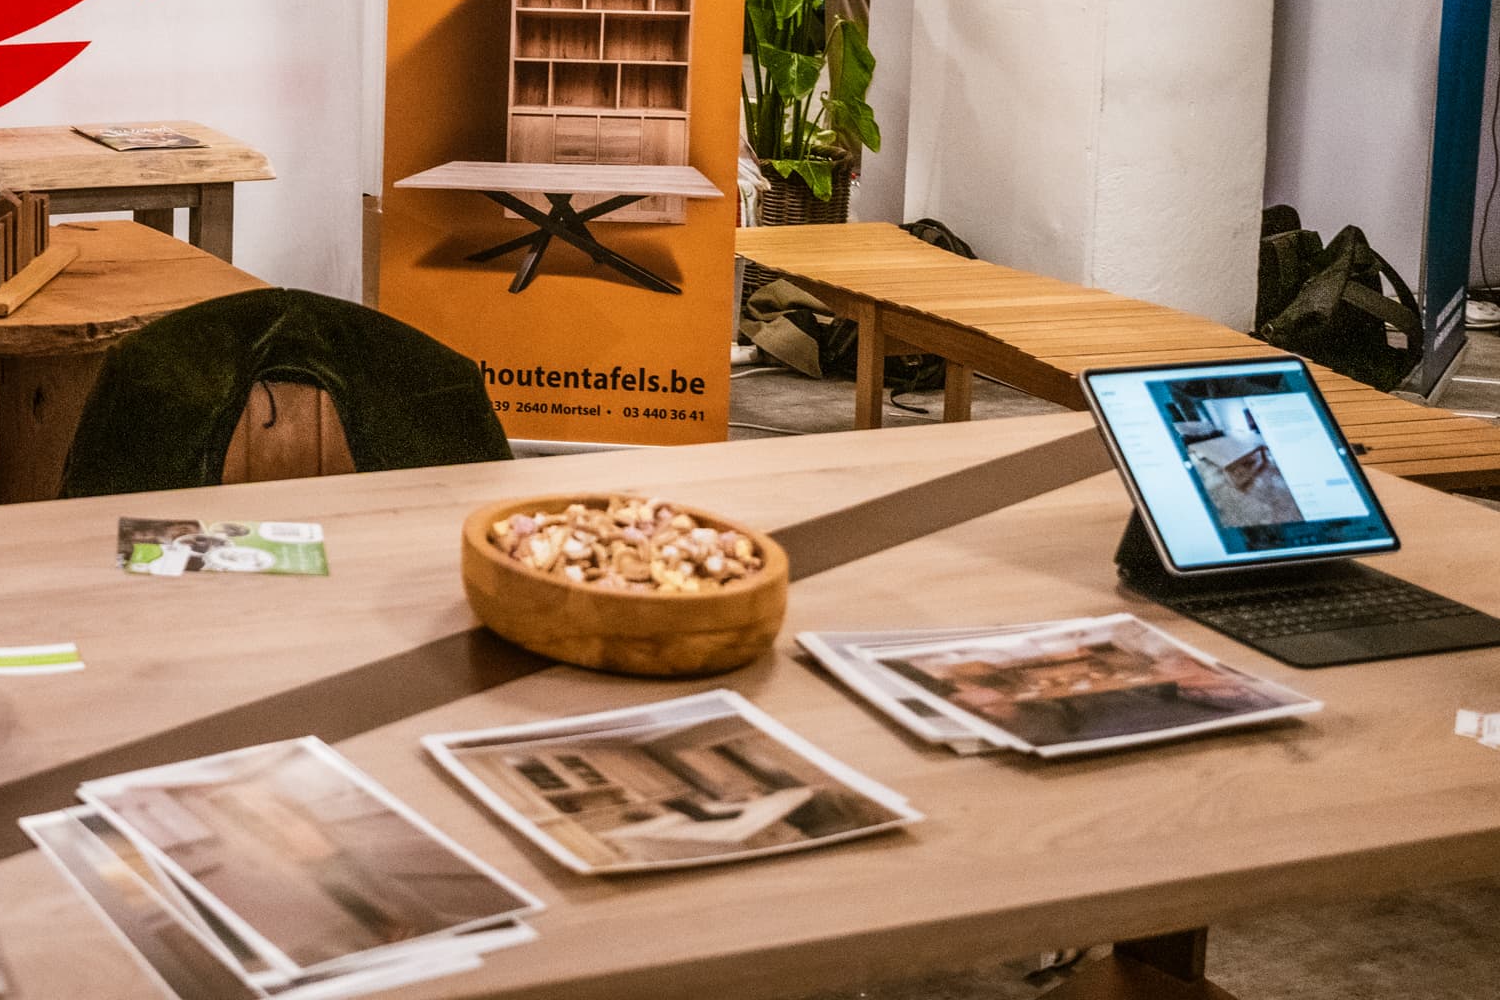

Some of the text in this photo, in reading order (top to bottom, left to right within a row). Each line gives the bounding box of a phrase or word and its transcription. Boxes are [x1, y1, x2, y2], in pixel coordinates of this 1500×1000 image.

[515, 402, 548, 414] 2640
[551, 403, 601, 417] Mortsel
[623, 407, 639, 419] 03
[642, 408, 667, 420] 440
[670, 409, 686, 421] 36
[688, 410, 705, 422] 41
